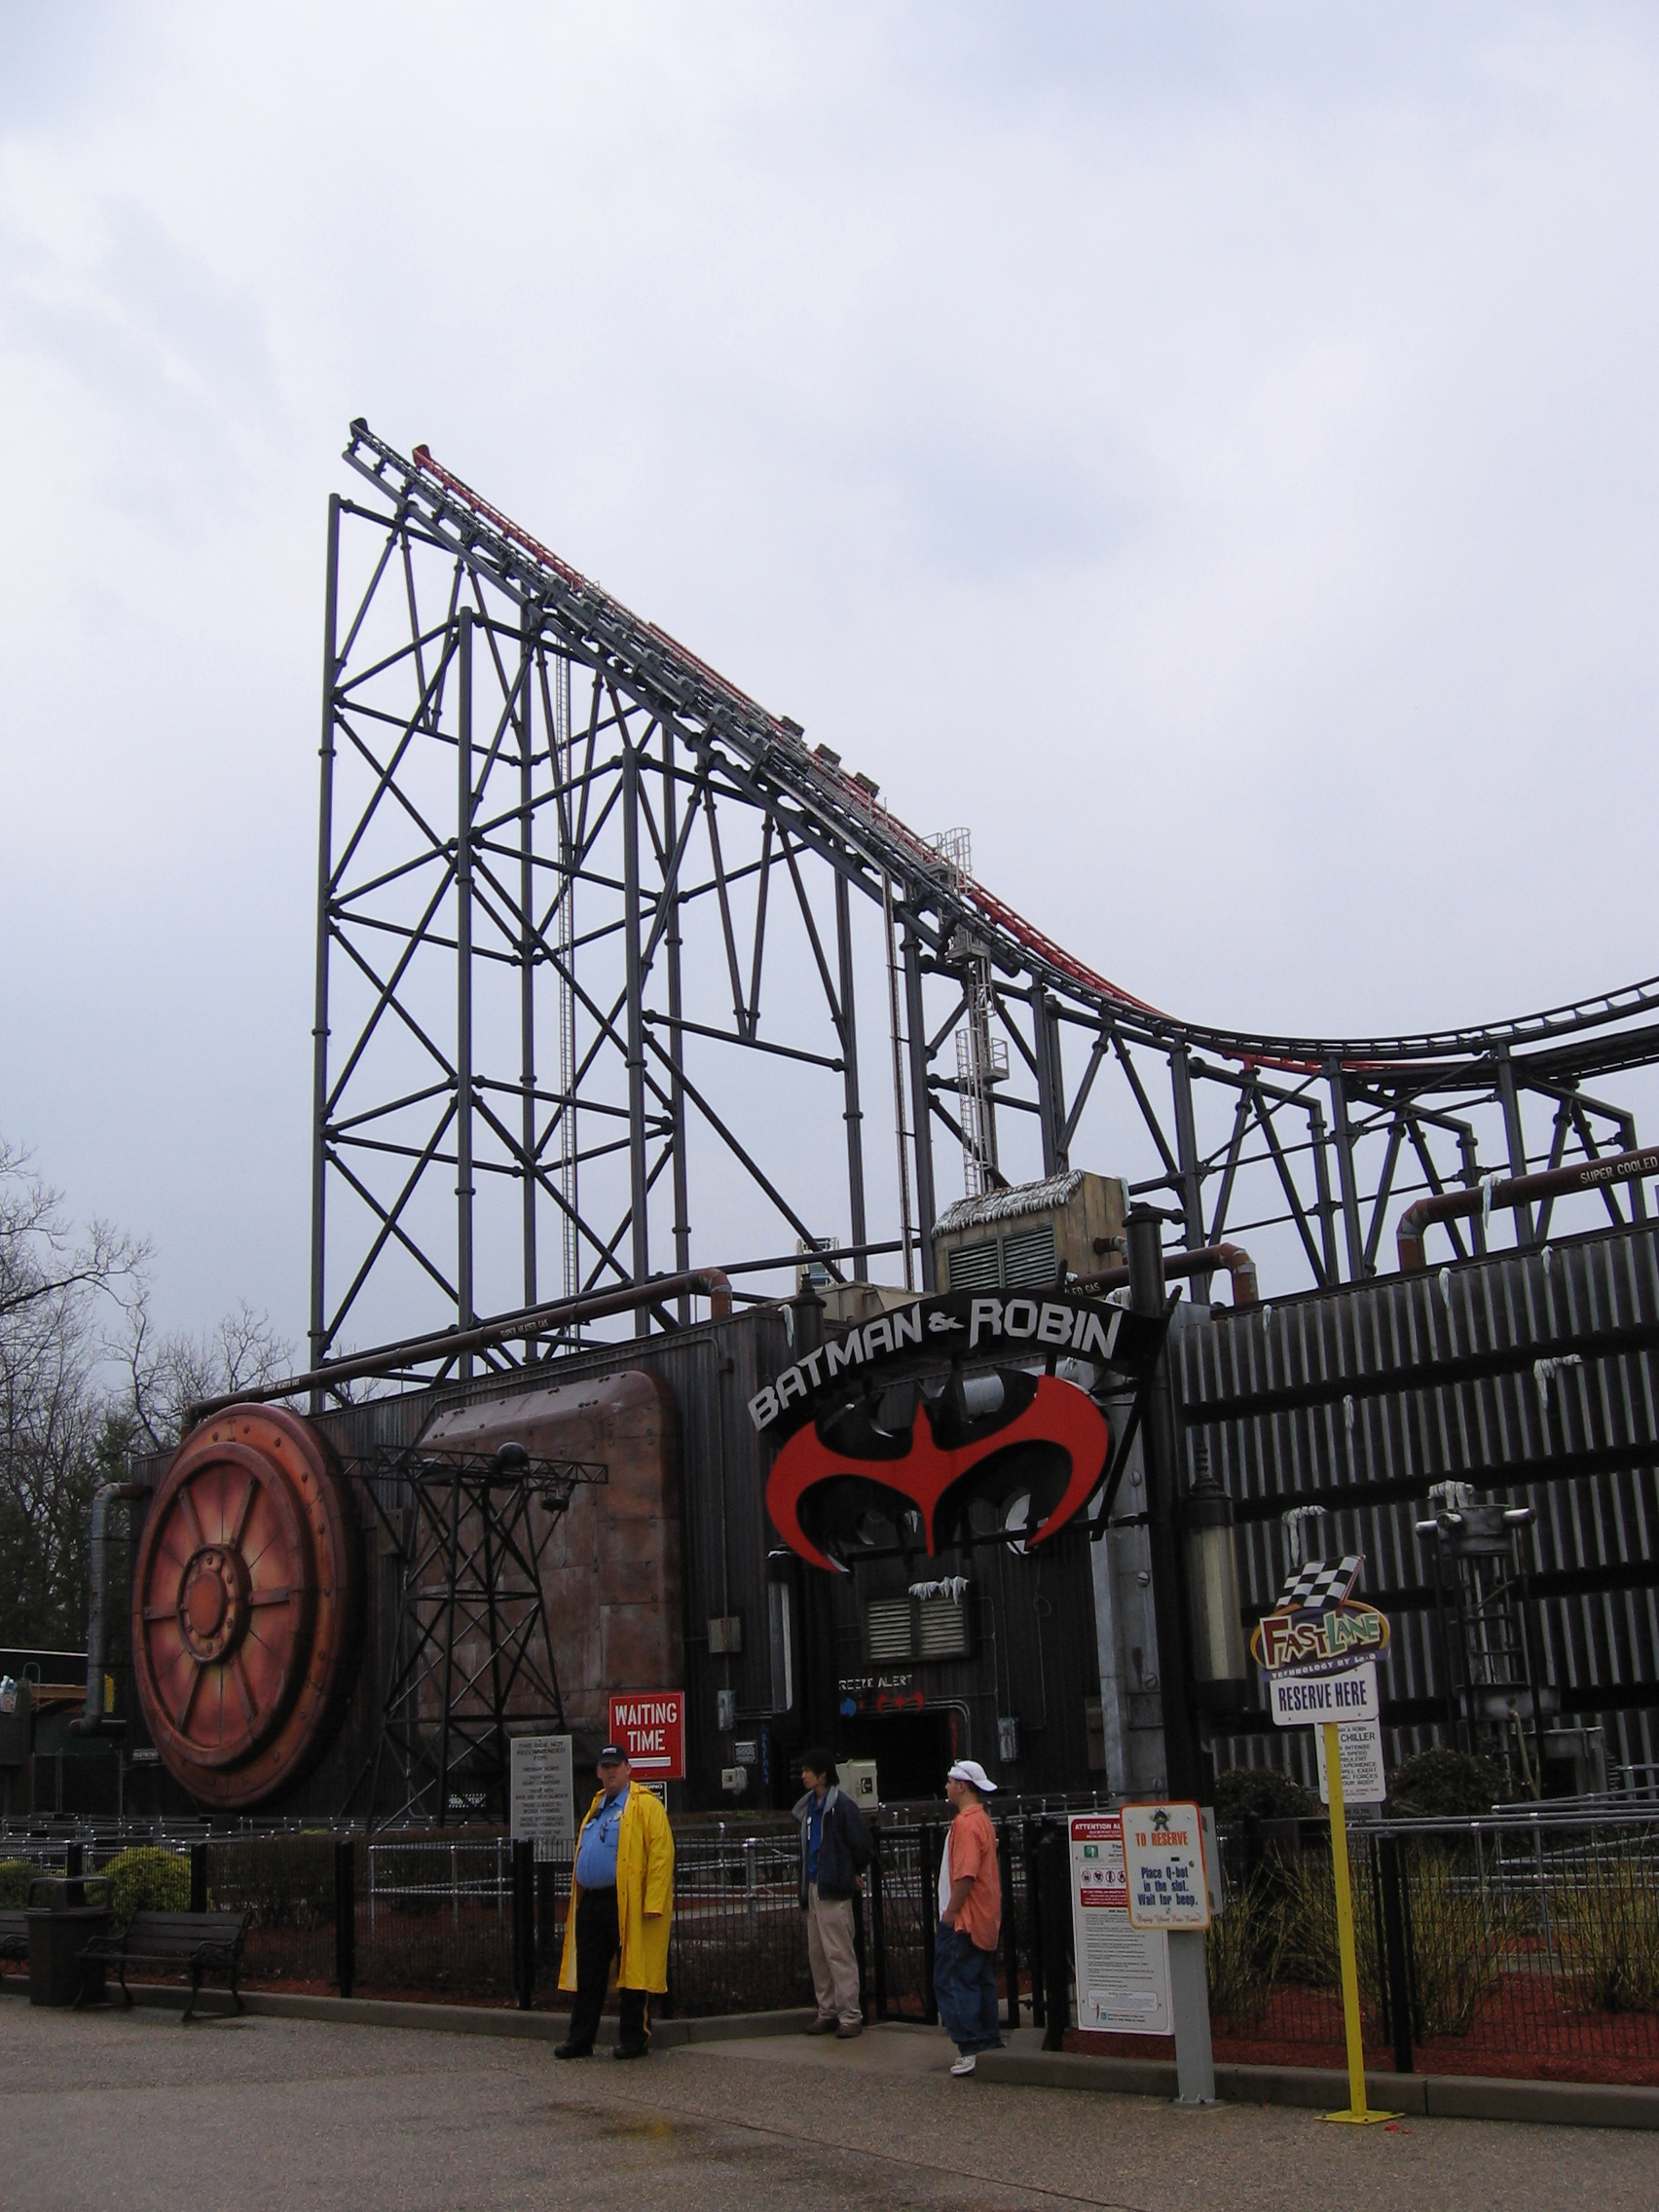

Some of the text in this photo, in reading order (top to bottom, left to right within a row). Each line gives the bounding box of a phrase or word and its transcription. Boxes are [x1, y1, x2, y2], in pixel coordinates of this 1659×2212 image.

[1580, 1156, 1658, 1184] SUPER COOLED
[747, 1298, 1123, 1433] BATMAN & ROBIN
[838, 1674, 912, 1691] REEZE ALERT
[1278, 1680, 1368, 1712] RESERVE HERE
[615, 1702, 678, 1726] WAITING
[627, 1729, 666, 1752] TIME
[1341, 1733, 1376, 1743] CHILLER
[1135, 1830, 1189, 1848] TO RESERVE
[1141, 1865, 1189, 1881] Place Q-bot
[1143, 1880, 1190, 1893] in the slot.
[1137, 1894, 1157, 1906] Wait
[1160, 1893, 1172, 1906] for
[1176, 1893, 1198, 1908] beep.
